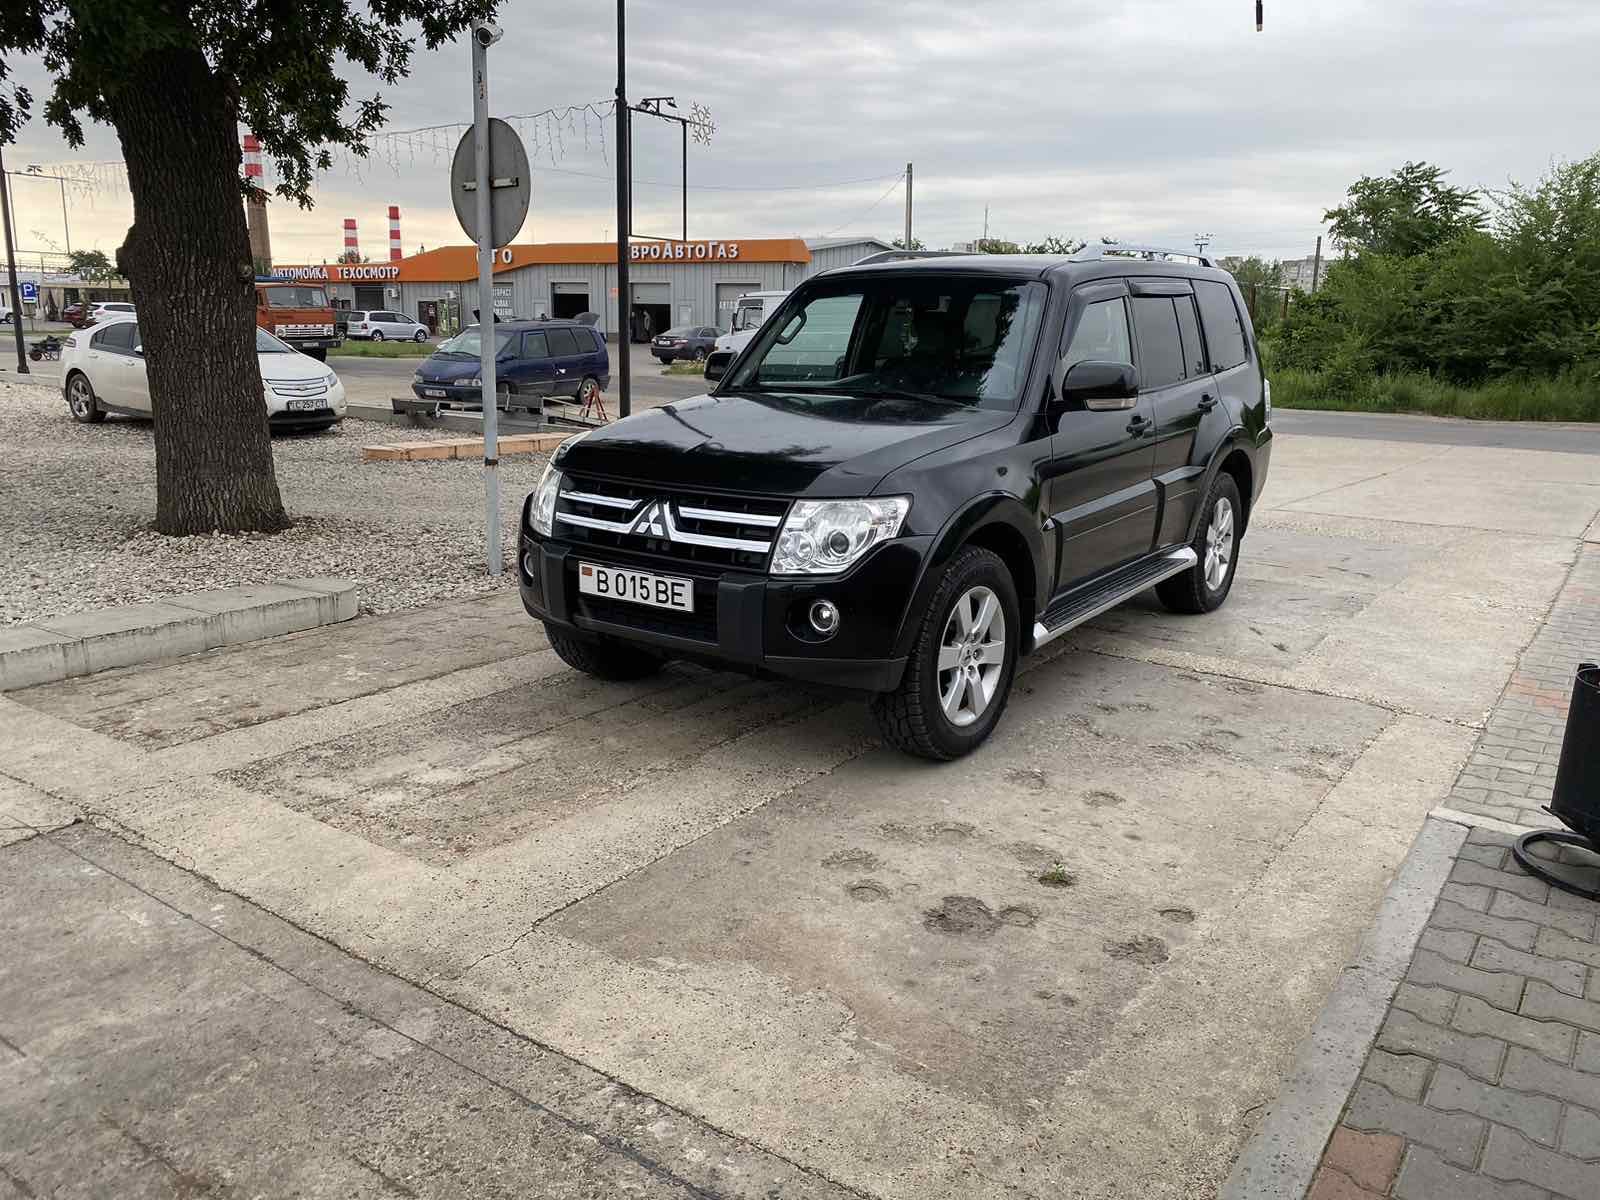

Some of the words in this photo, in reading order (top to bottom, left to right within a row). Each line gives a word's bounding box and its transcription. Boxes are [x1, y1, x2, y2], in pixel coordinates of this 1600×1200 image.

[476, 248, 512, 264] ТО
[337, 266, 399, 279] ТЕХОСМОТР
[23, 284, 32, 296] P
[597, 570, 609, 593] B
[615, 573, 650, 600] 015
[655, 579, 685, 607] BE
